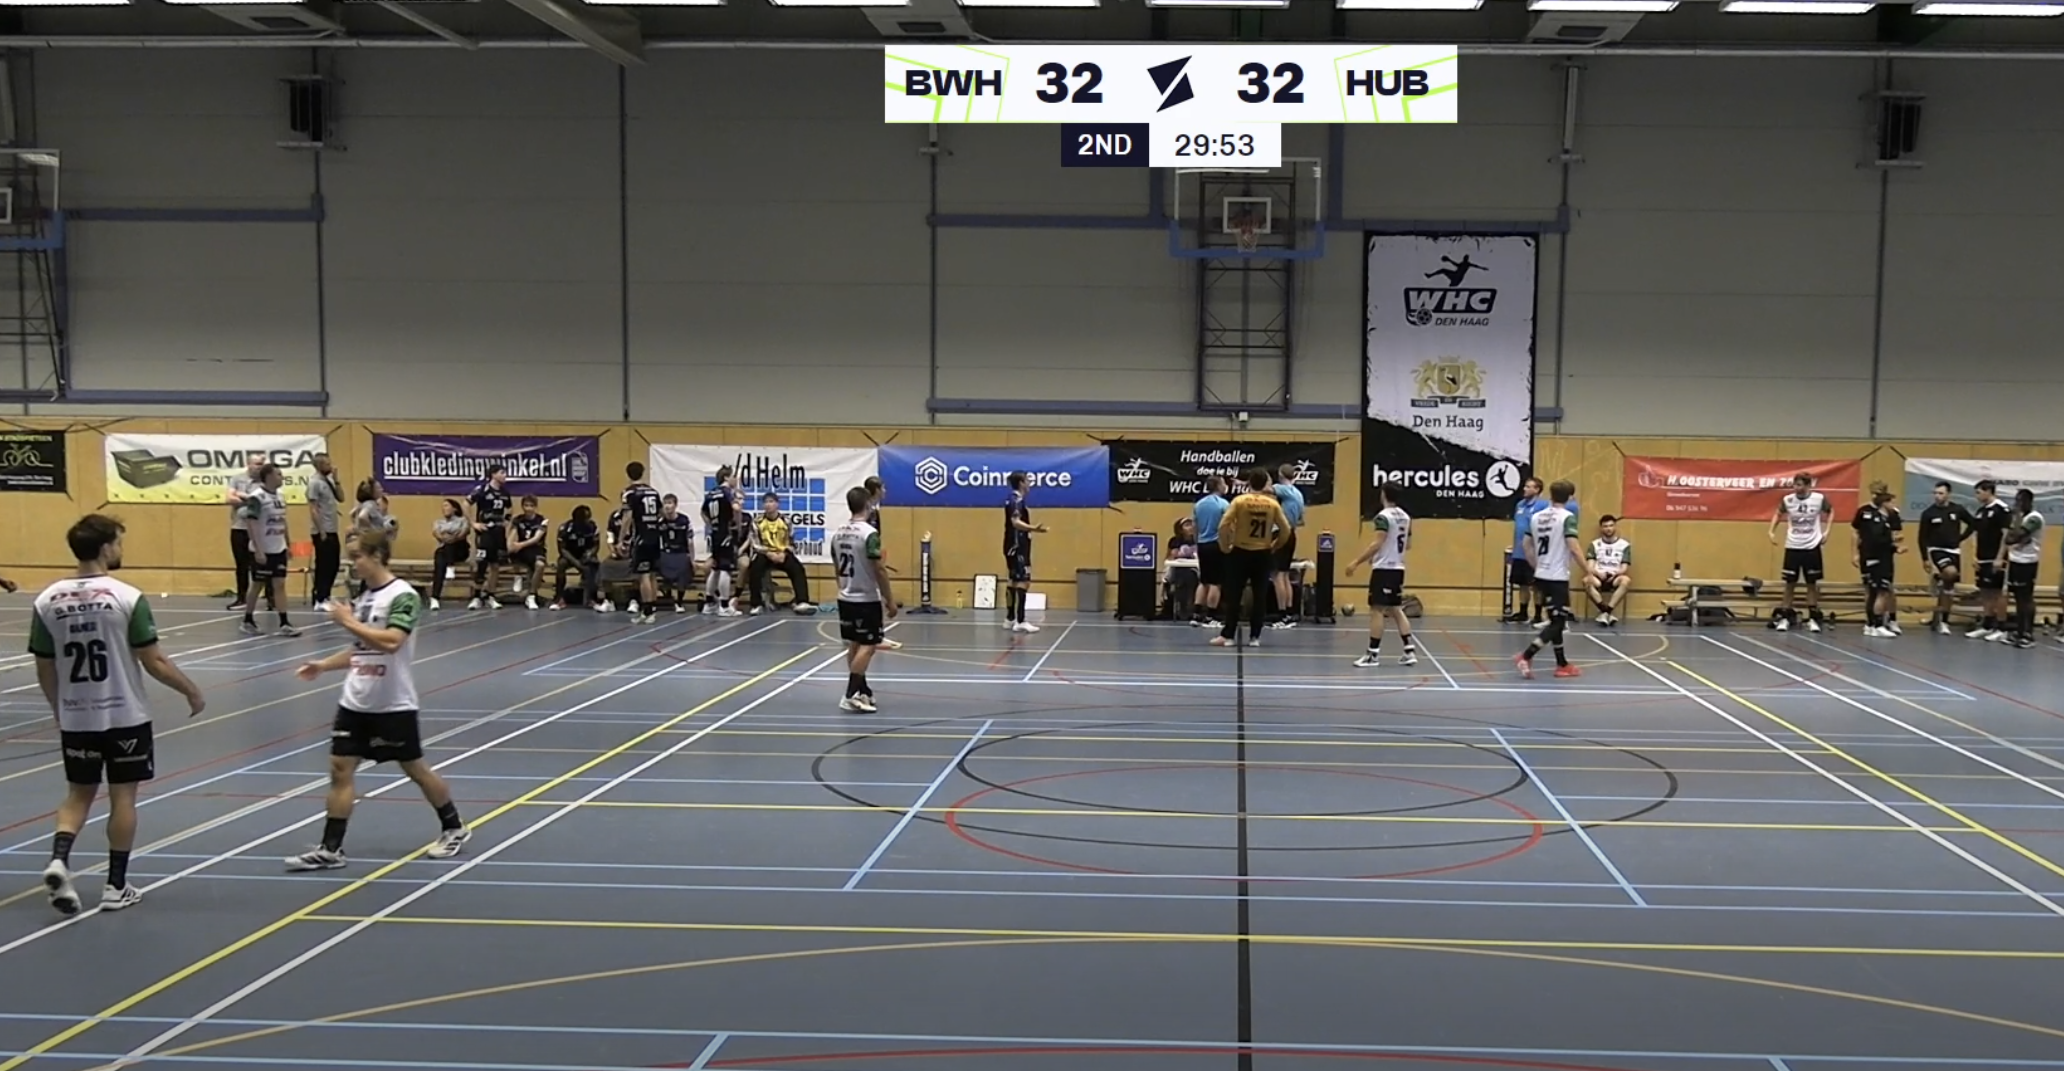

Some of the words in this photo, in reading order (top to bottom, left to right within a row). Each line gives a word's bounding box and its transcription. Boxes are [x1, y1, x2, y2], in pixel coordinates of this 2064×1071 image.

[1408, 290, 1492, 312] WHC
[1435, 317, 1459, 326] DEN
[1459, 317, 1490, 326] HAAG
[1412, 415, 1442, 428] Den
[1445, 415, 1485, 432] Haag
[1180, 450, 1255, 464] Handballen
[756, 453, 806, 489] Helm
[1196, 467, 1215, 476] doe
[1226, 467, 1240, 478] bij
[1372, 464, 1480, 488] hercules
[1169, 481, 1201, 494] WHC
[1759, 477, 1774, 488] EN
[1436, 490, 1456, 498] DEN
[1457, 490, 1485, 499] HAAG
[641, 496, 657, 515] 15
[1250, 519, 1266, 538] 21
[1397, 534, 1406, 554] 6
[63, 639, 108, 684] 26
